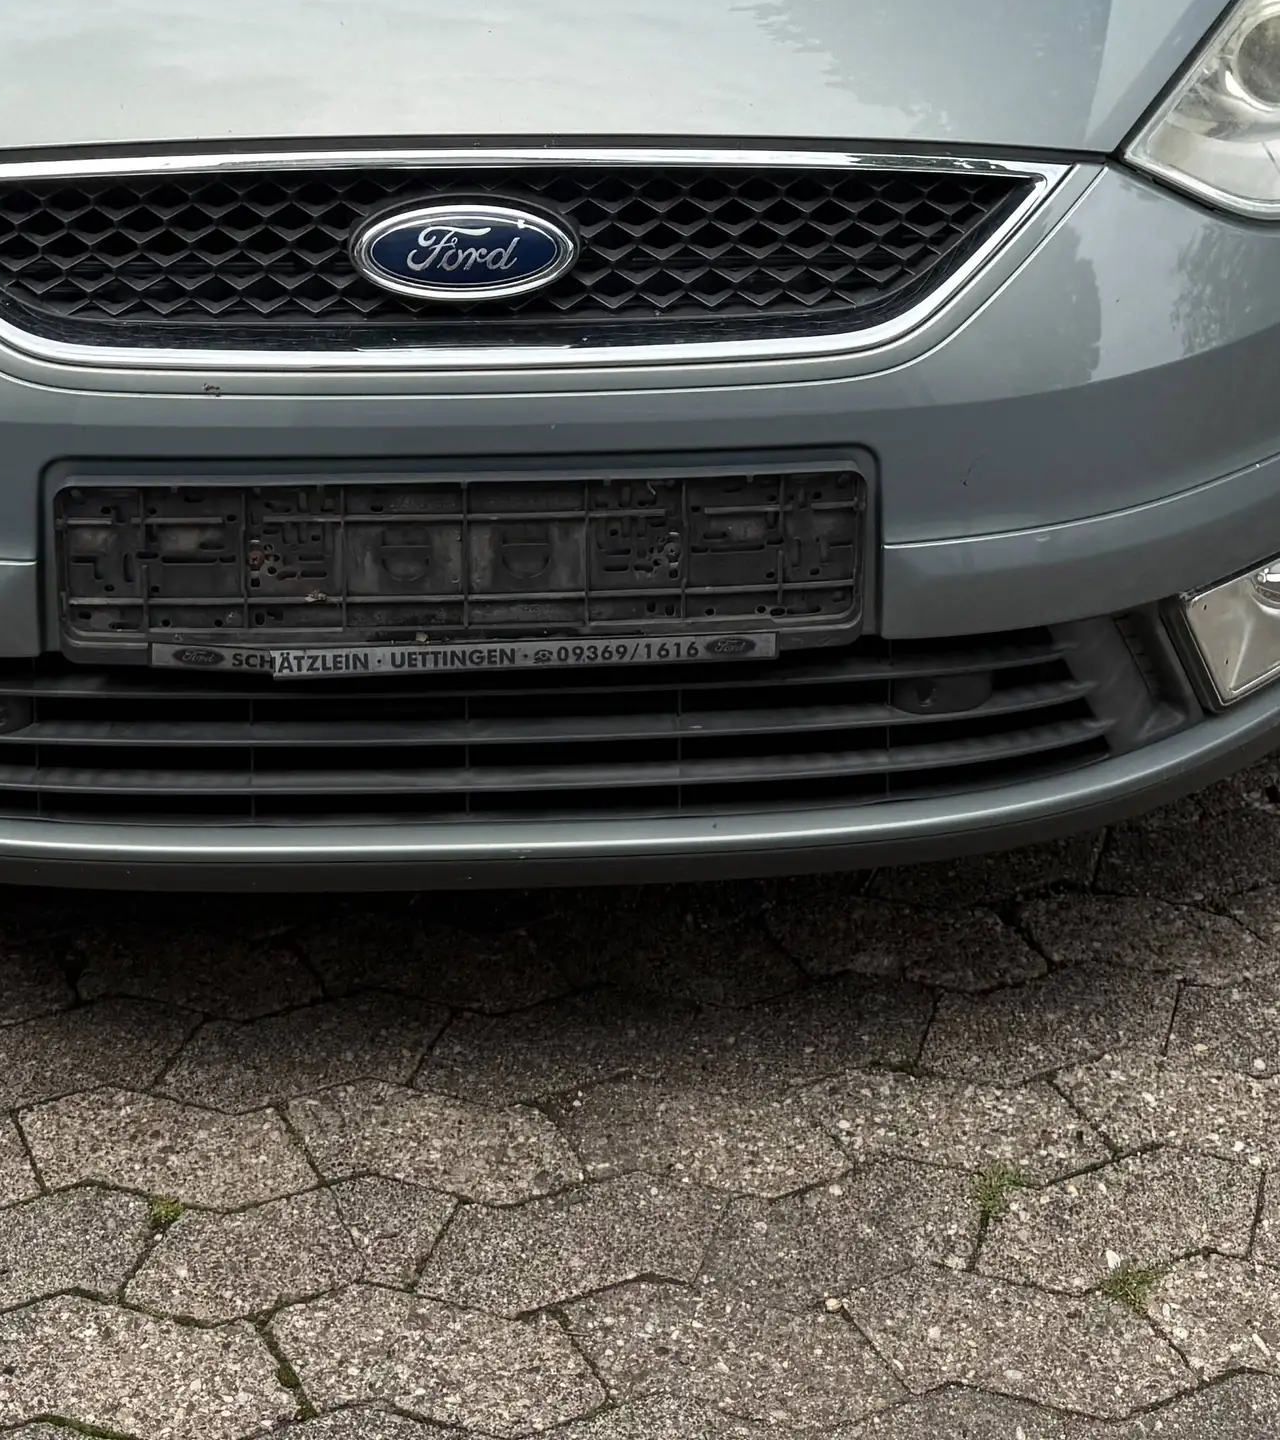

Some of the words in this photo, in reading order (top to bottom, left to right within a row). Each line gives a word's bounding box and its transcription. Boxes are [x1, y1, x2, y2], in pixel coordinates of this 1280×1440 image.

[406, 225, 521, 272] Ford
[231, 651, 370, 673] SCHÄTZLEIN
[390, 648, 516, 669] UETTINGEN
[556, 640, 700, 662] 09369/1616
